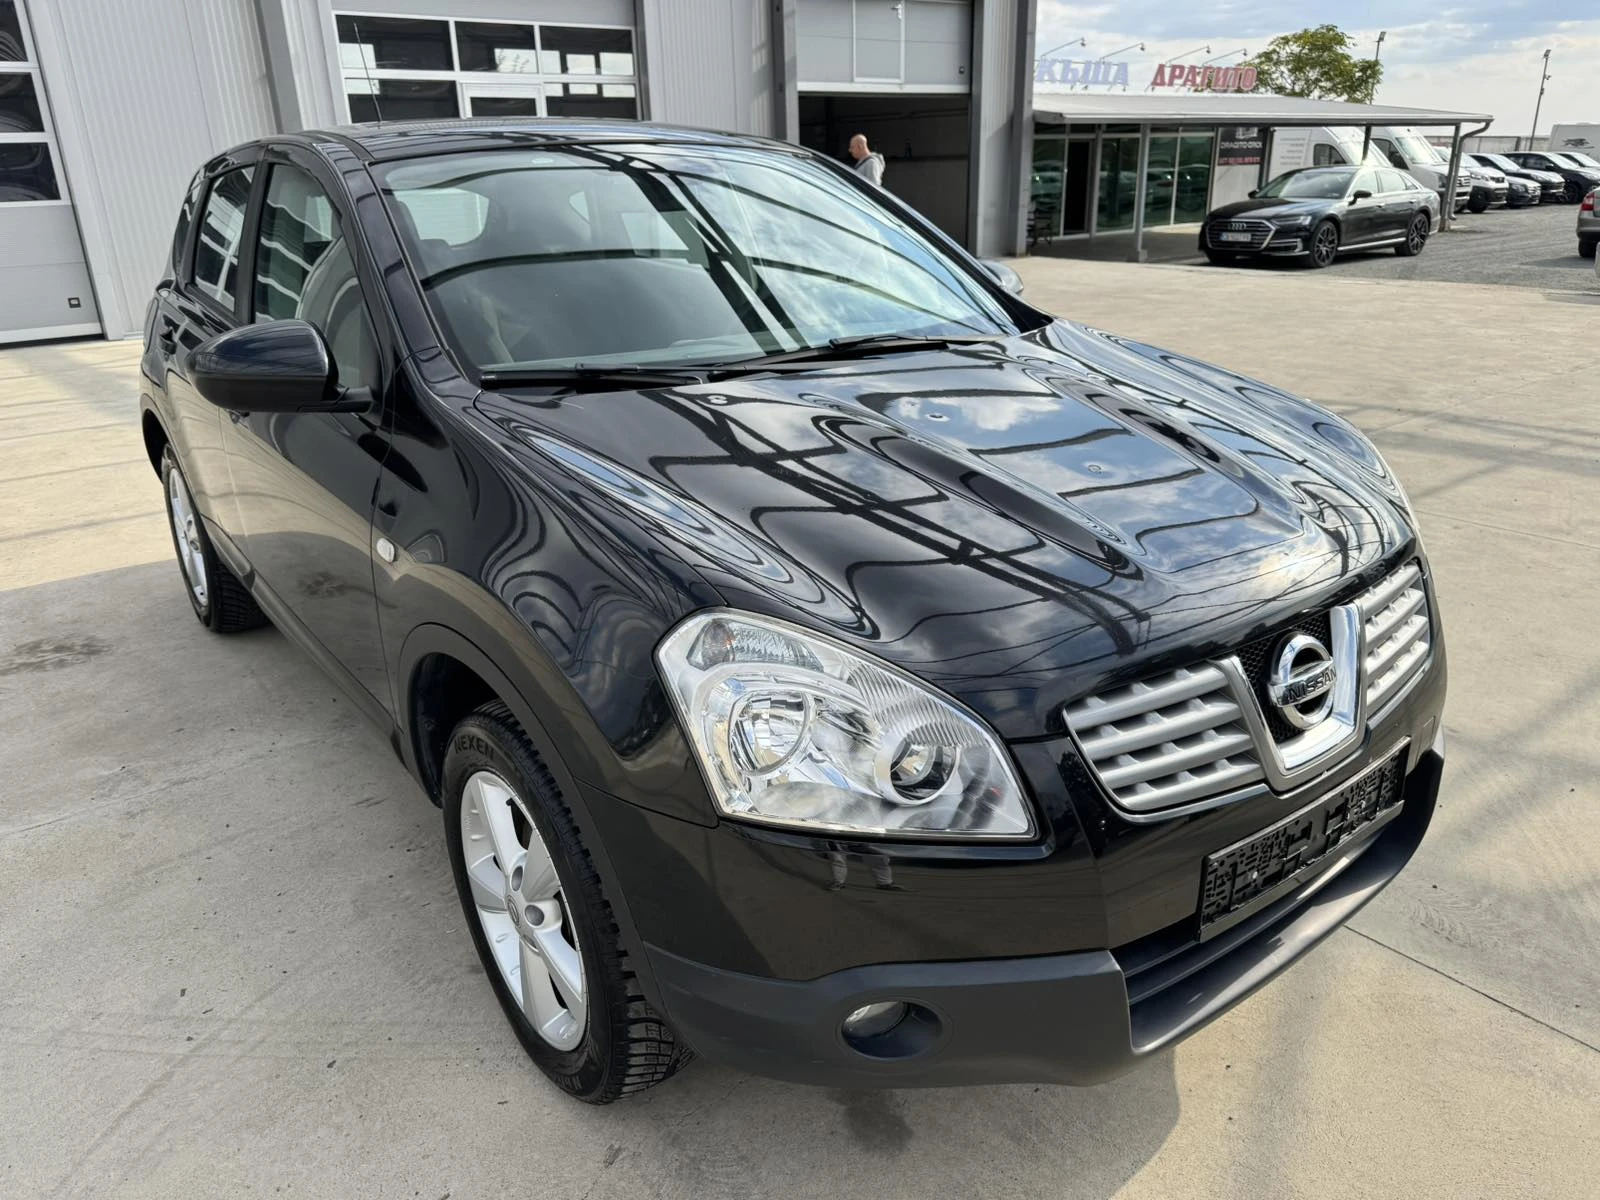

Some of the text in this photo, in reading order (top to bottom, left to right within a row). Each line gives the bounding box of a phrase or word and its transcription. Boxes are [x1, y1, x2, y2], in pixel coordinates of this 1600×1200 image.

[1151, 64, 1257, 90] ДРАГИТО
[1286, 666, 1337, 703] NISSAN
[454, 735, 494, 760] NEXEN
